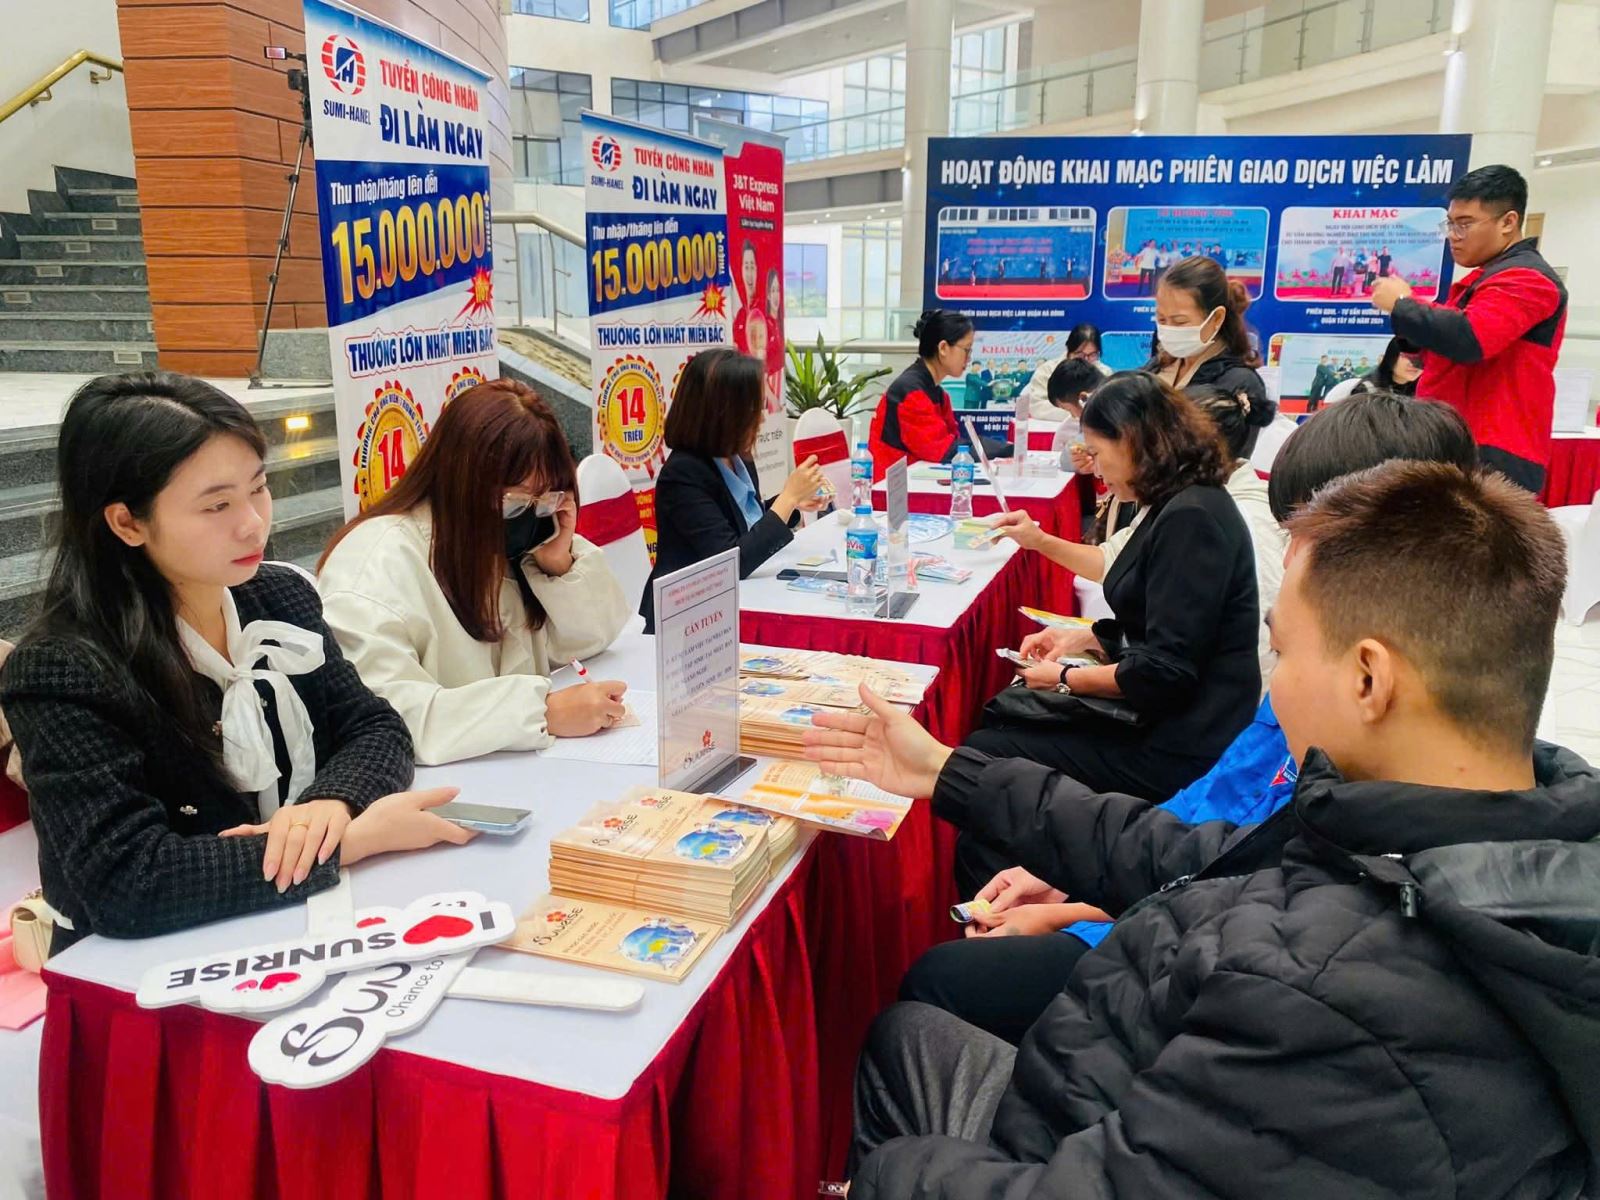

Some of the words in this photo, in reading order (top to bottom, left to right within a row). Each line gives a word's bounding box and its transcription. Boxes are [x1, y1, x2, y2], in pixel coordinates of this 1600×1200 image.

[380, 59, 419, 95] TUYỂN
[422, 73, 452, 104] CÔNG
[323, 99, 371, 125] SUMI-HANEL
[380, 103, 400, 144] ĐI
[404, 100, 440, 152] LÀM
[444, 121, 483, 160] NGAY
[632, 175, 649, 201] ĐI
[653, 171, 681, 205] LÀM
[685, 184, 717, 210] NGAY
[941, 159, 994, 190] HOẠT
[999, 154, 1056, 189] ĐỘNG
[1061, 159, 1110, 184] KHAI
[1116, 159, 1164, 189] MẠC
[1169, 154, 1233, 184] PHIÊN
[1239, 159, 1288, 184] GIAO
[1294, 159, 1345, 189] DỊCH
[1351, 154, 1399, 189] VIỆC
[1404, 154, 1453, 184] LÀM
[330, 182, 352, 205] Thu
[755, 197, 774, 213] Nam
[1333, 209, 1366, 219] KHAI
[616, 386, 646, 426] 14
[166, 932, 396, 990] SUNRISE
[386, 971, 434, 1018] Chance
[424, 958, 445, 980] to
